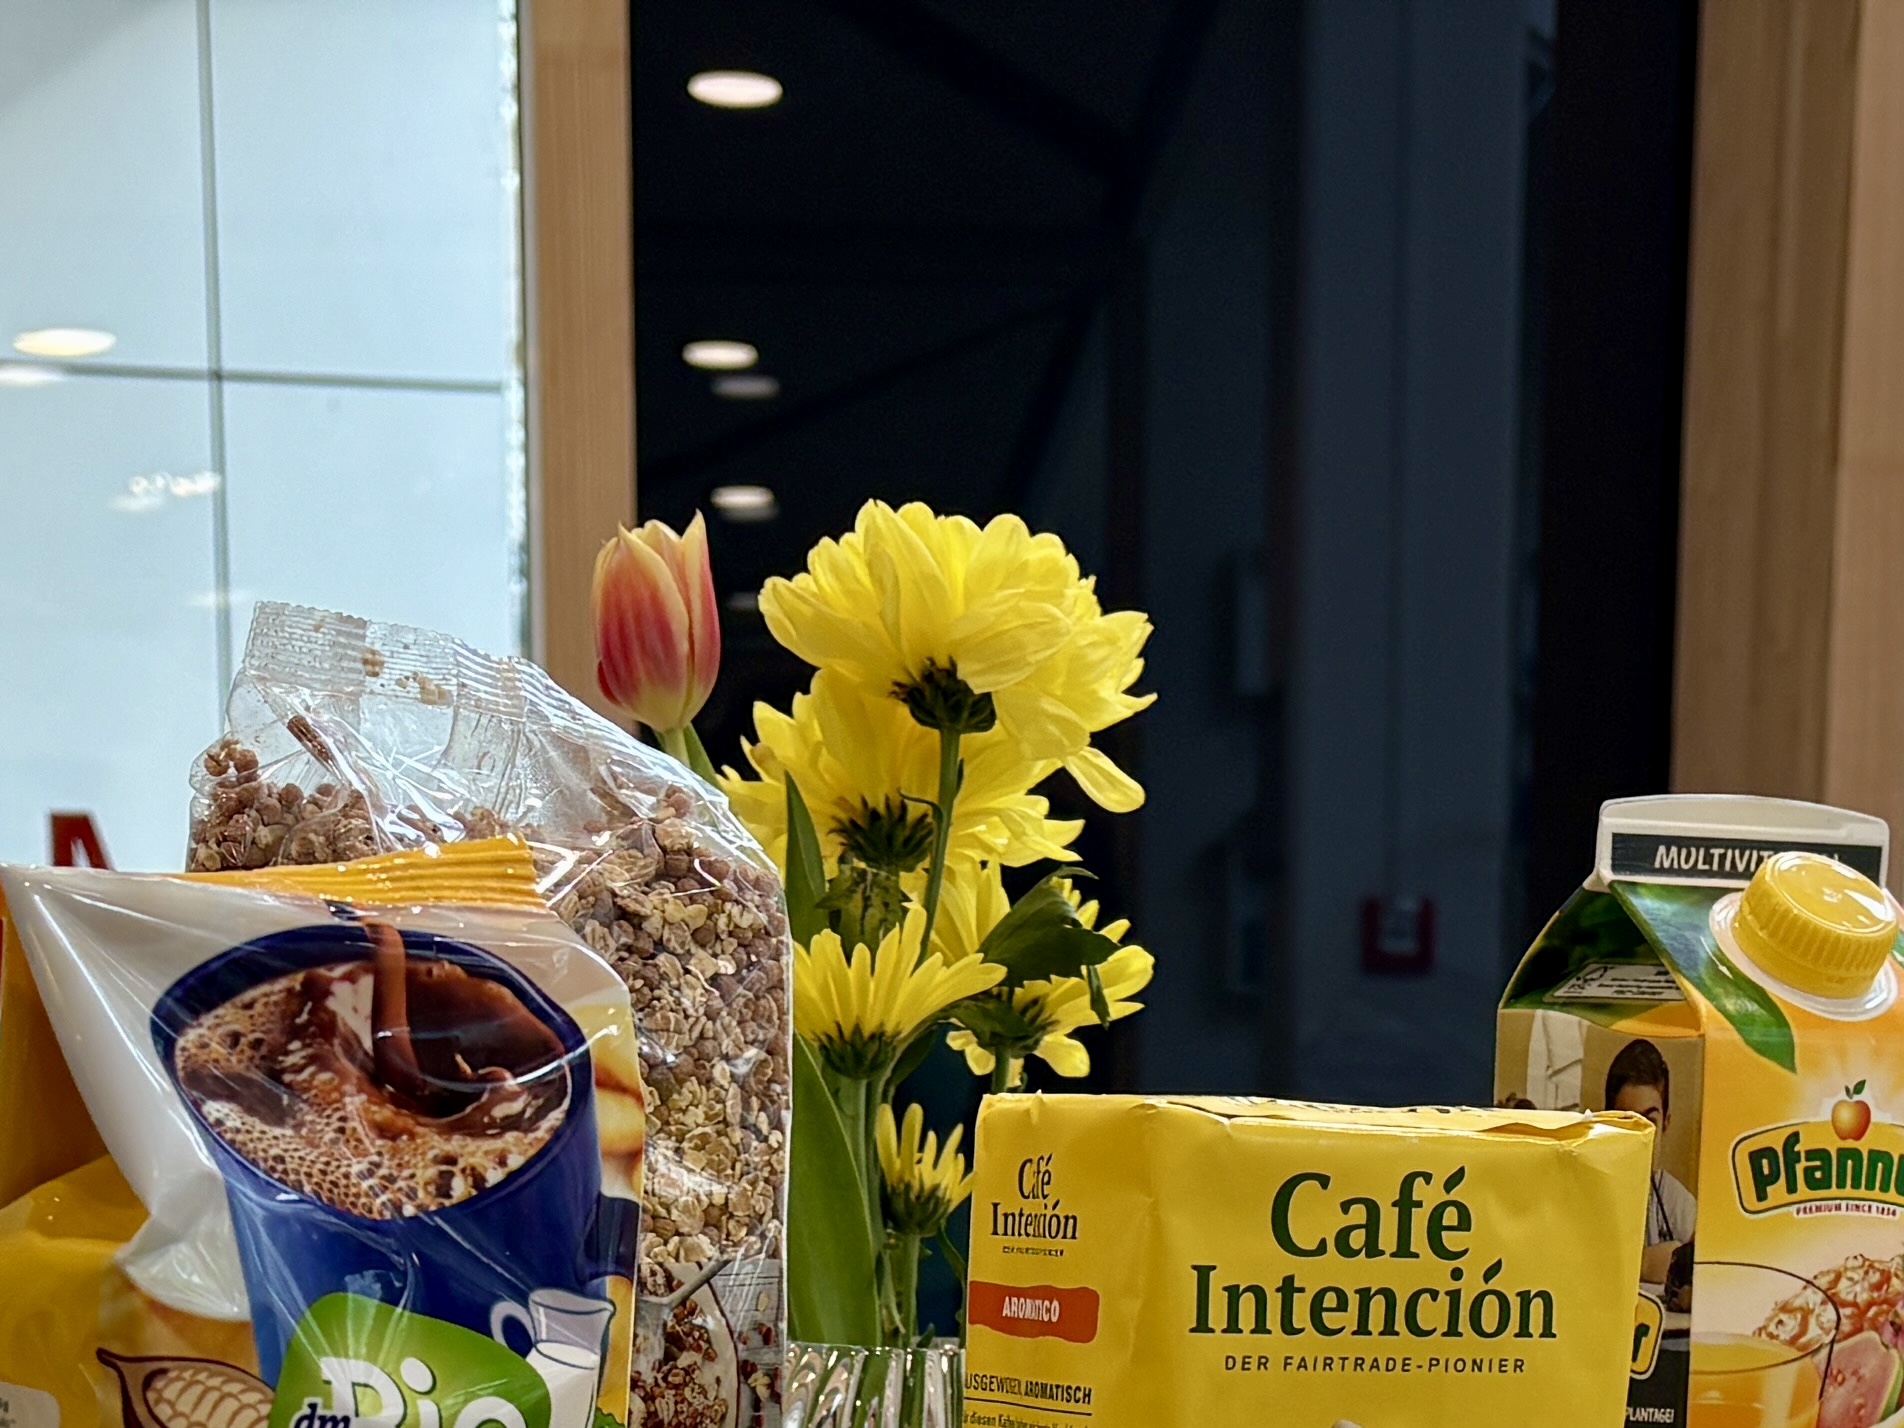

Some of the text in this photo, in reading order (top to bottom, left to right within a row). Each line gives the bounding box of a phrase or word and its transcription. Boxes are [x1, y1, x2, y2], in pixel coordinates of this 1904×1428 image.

[1270, 1165, 1473, 1260] Café
[1795, 1203, 1874, 1217] PREMIUM SINCE
[1188, 1258, 1558, 1341] Intención
[1224, 1354, 1527, 1376] DER FAIRTRADE-PIONIER
